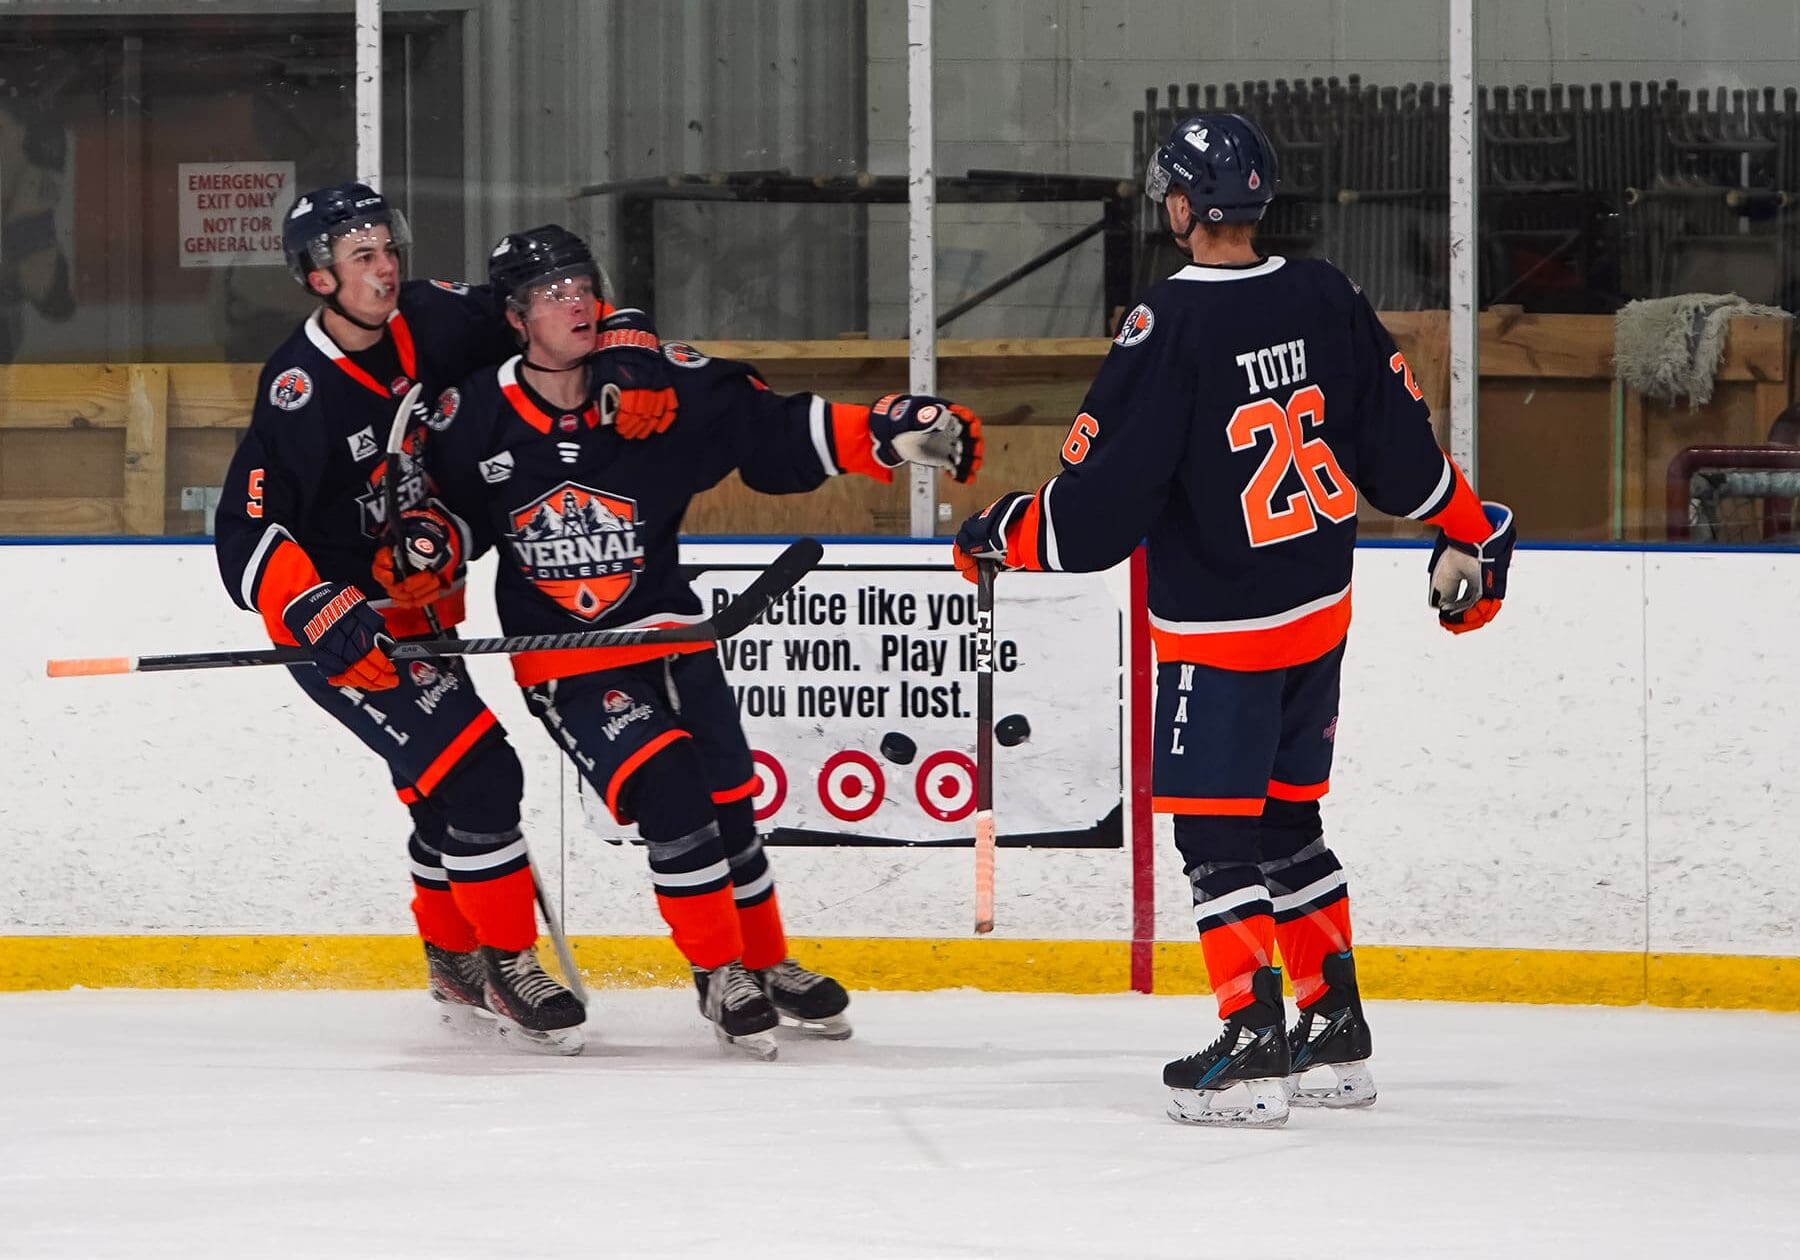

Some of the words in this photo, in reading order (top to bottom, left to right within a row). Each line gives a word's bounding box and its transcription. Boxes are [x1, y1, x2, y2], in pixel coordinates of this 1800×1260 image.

[188, 173, 286, 191] EMERGENCY
[1172, 162, 1194, 181] CCM
[197, 193, 235, 209] EXIT
[237, 192, 277, 208] ONLY
[184, 235, 256, 253] GENERAL
[260, 235, 283, 252] US
[203, 217, 236, 233] NOT
[240, 217, 272, 232] FOR
[1236, 338, 1307, 394] TOTH
[1390, 352, 1424, 401] 2
[1061, 412, 1100, 465] 6
[1226, 384, 1358, 548] 26
[512, 531, 645, 567] VERNAL
[538, 562, 624, 579] OILERS
[712, 586, 846, 626] Pctice
[858, 586, 916, 626] like
[784, 639, 861, 672] won.
[882, 634, 947, 677] Play
[959, 633, 1018, 673] lie
[977, 609, 993, 674] CCM
[797, 686, 890, 719] never
[901, 681, 971, 719] lost.
